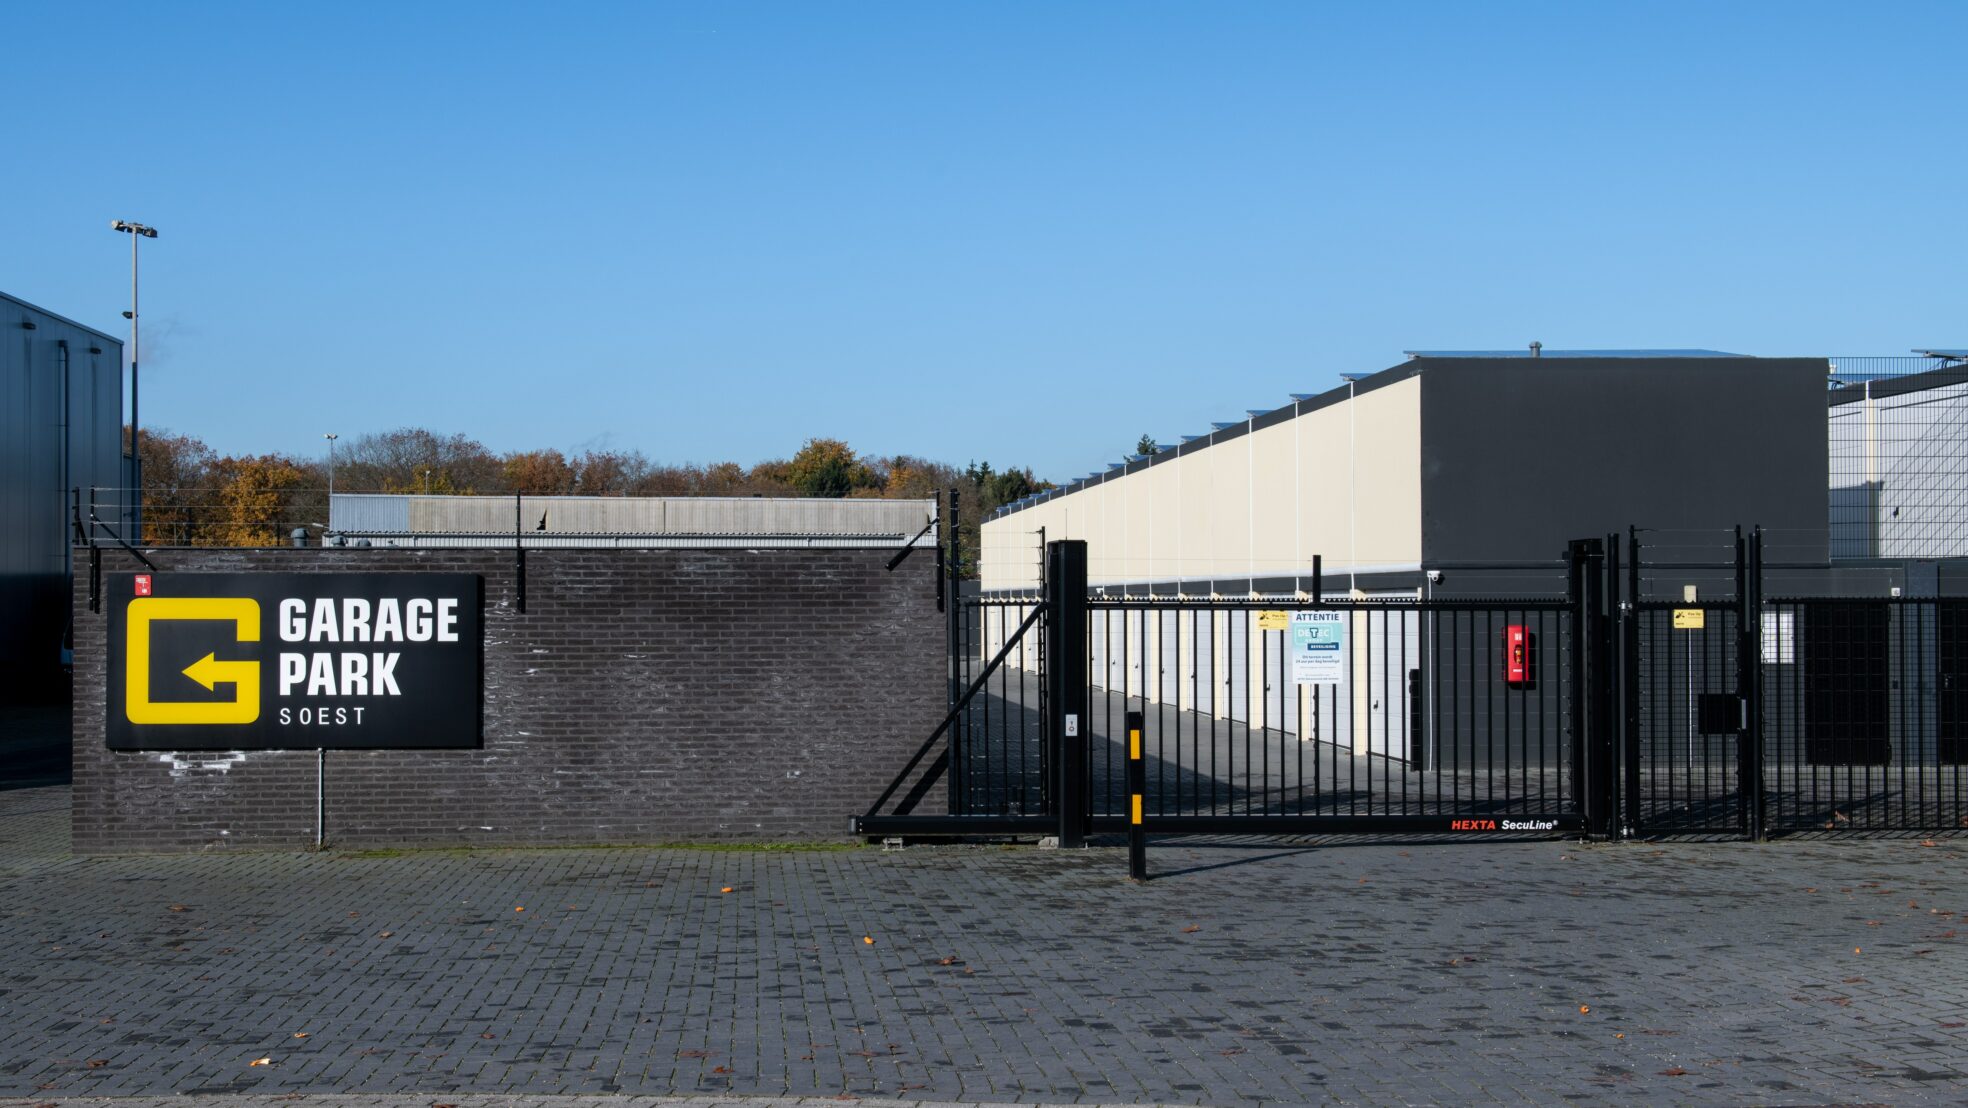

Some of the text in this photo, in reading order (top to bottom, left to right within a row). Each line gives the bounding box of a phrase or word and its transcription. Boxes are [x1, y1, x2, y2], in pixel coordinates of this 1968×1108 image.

[279, 598, 459, 642] GARAGE
[1296, 613, 1340, 621] ATTENTIE
[1297, 627, 1330, 639] DETEC
[279, 652, 402, 696] PARK
[279, 707, 365, 725] SOEST
[1451, 820, 1496, 830] HEXTA
